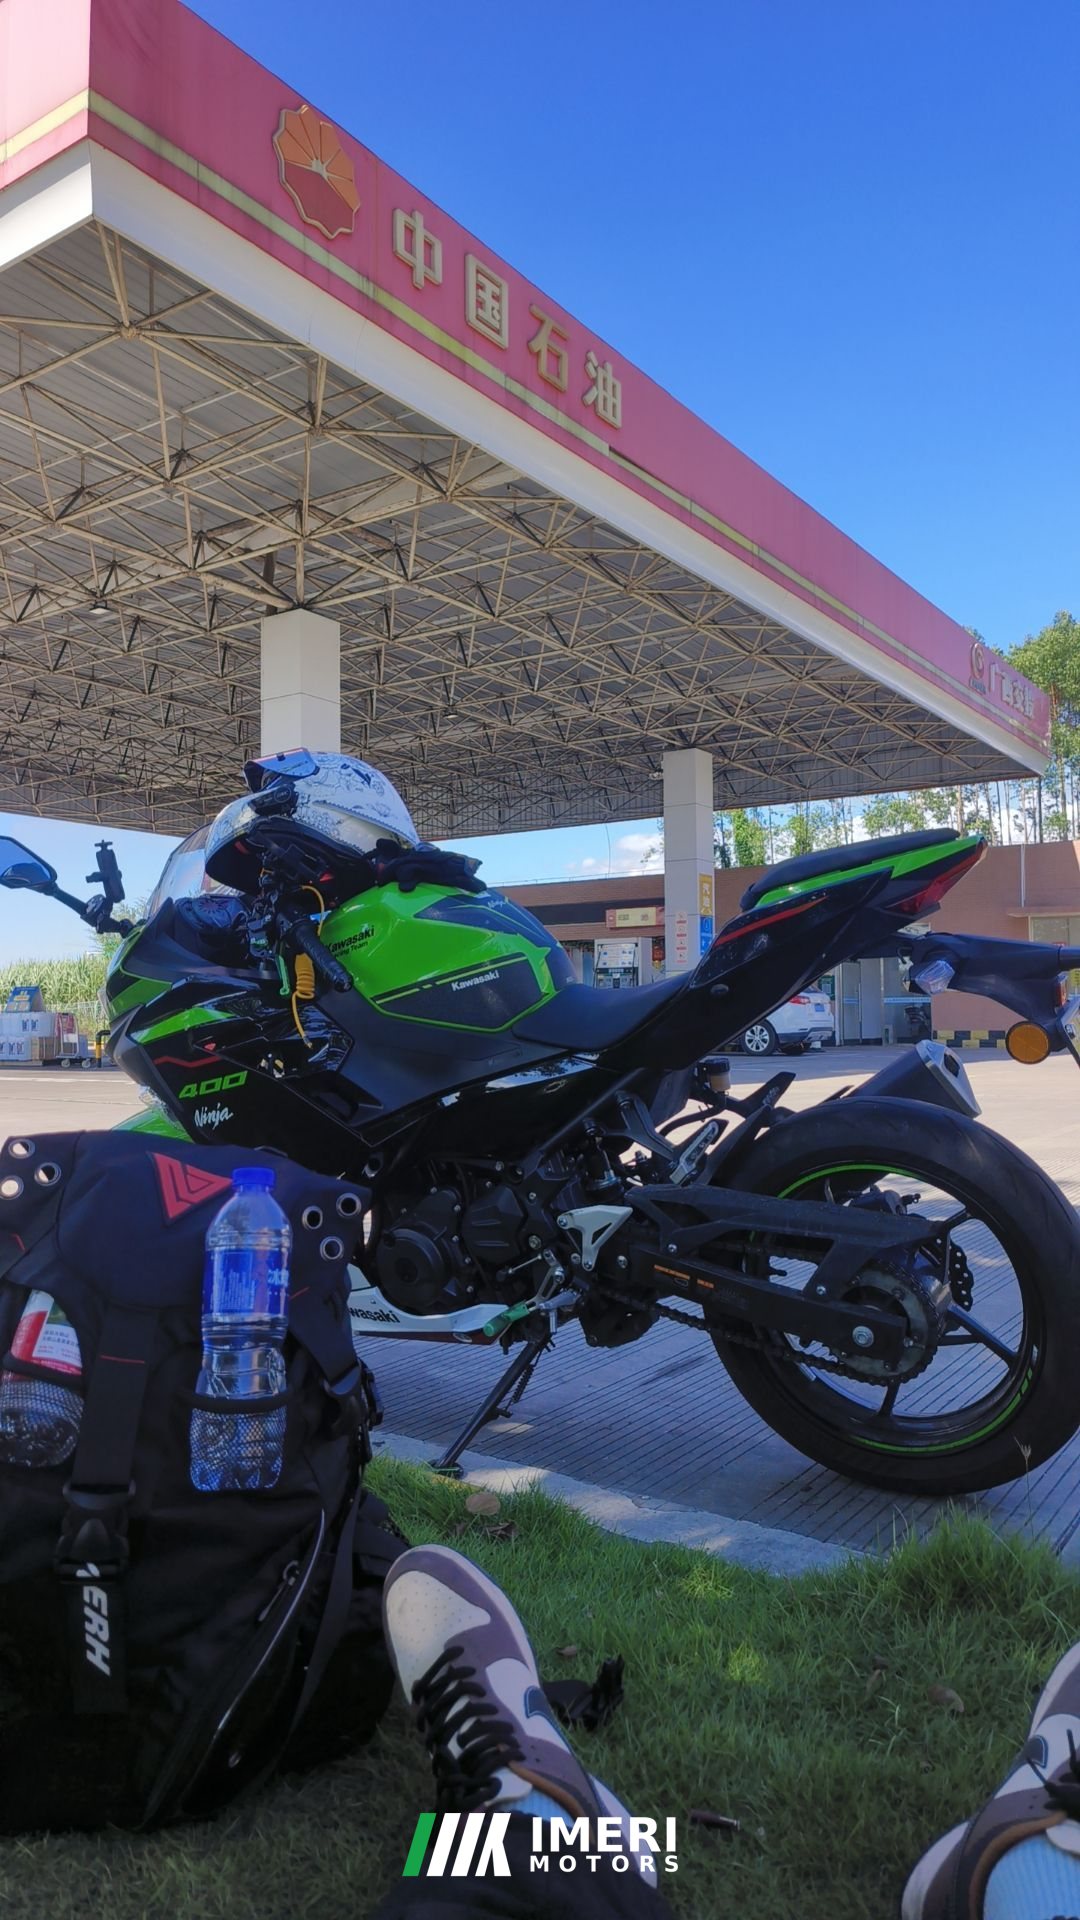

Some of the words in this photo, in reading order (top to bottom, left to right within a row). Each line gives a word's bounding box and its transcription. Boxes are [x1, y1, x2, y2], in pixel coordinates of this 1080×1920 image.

[392, 208, 622, 429] 中国石油
[451, 969, 500, 991] Kawasaki
[179, 1070, 248, 1099] 400
[194, 1102, 234, 1130] Ninja
[350, 1308, 401, 1323] wasaki
